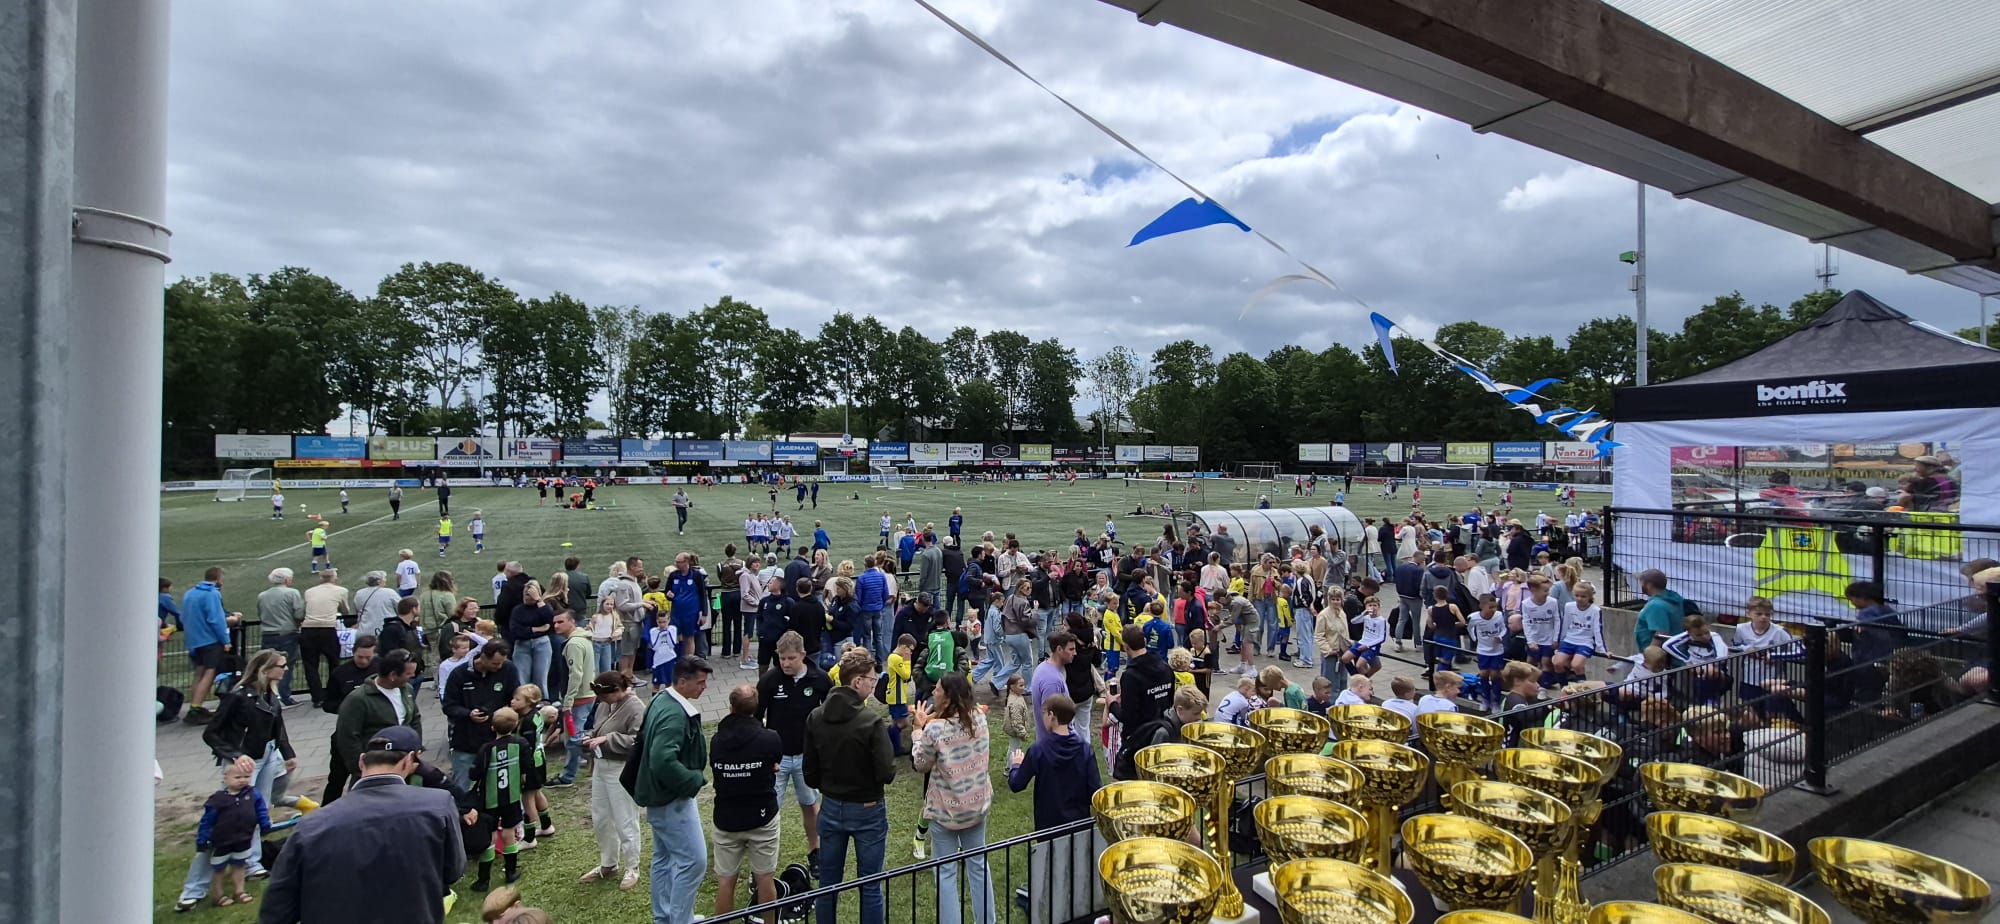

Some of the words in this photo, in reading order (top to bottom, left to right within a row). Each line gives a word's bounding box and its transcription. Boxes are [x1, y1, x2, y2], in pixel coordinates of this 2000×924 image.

[1757, 380, 1846, 401] bonfix
[387, 440, 432, 451] PLUS
[1458, 446, 1488, 455] PLUS
[1219, 699, 1230, 713] 2
[724, 761, 762, 770] DALFSEN
[498, 768, 508, 789] 3
